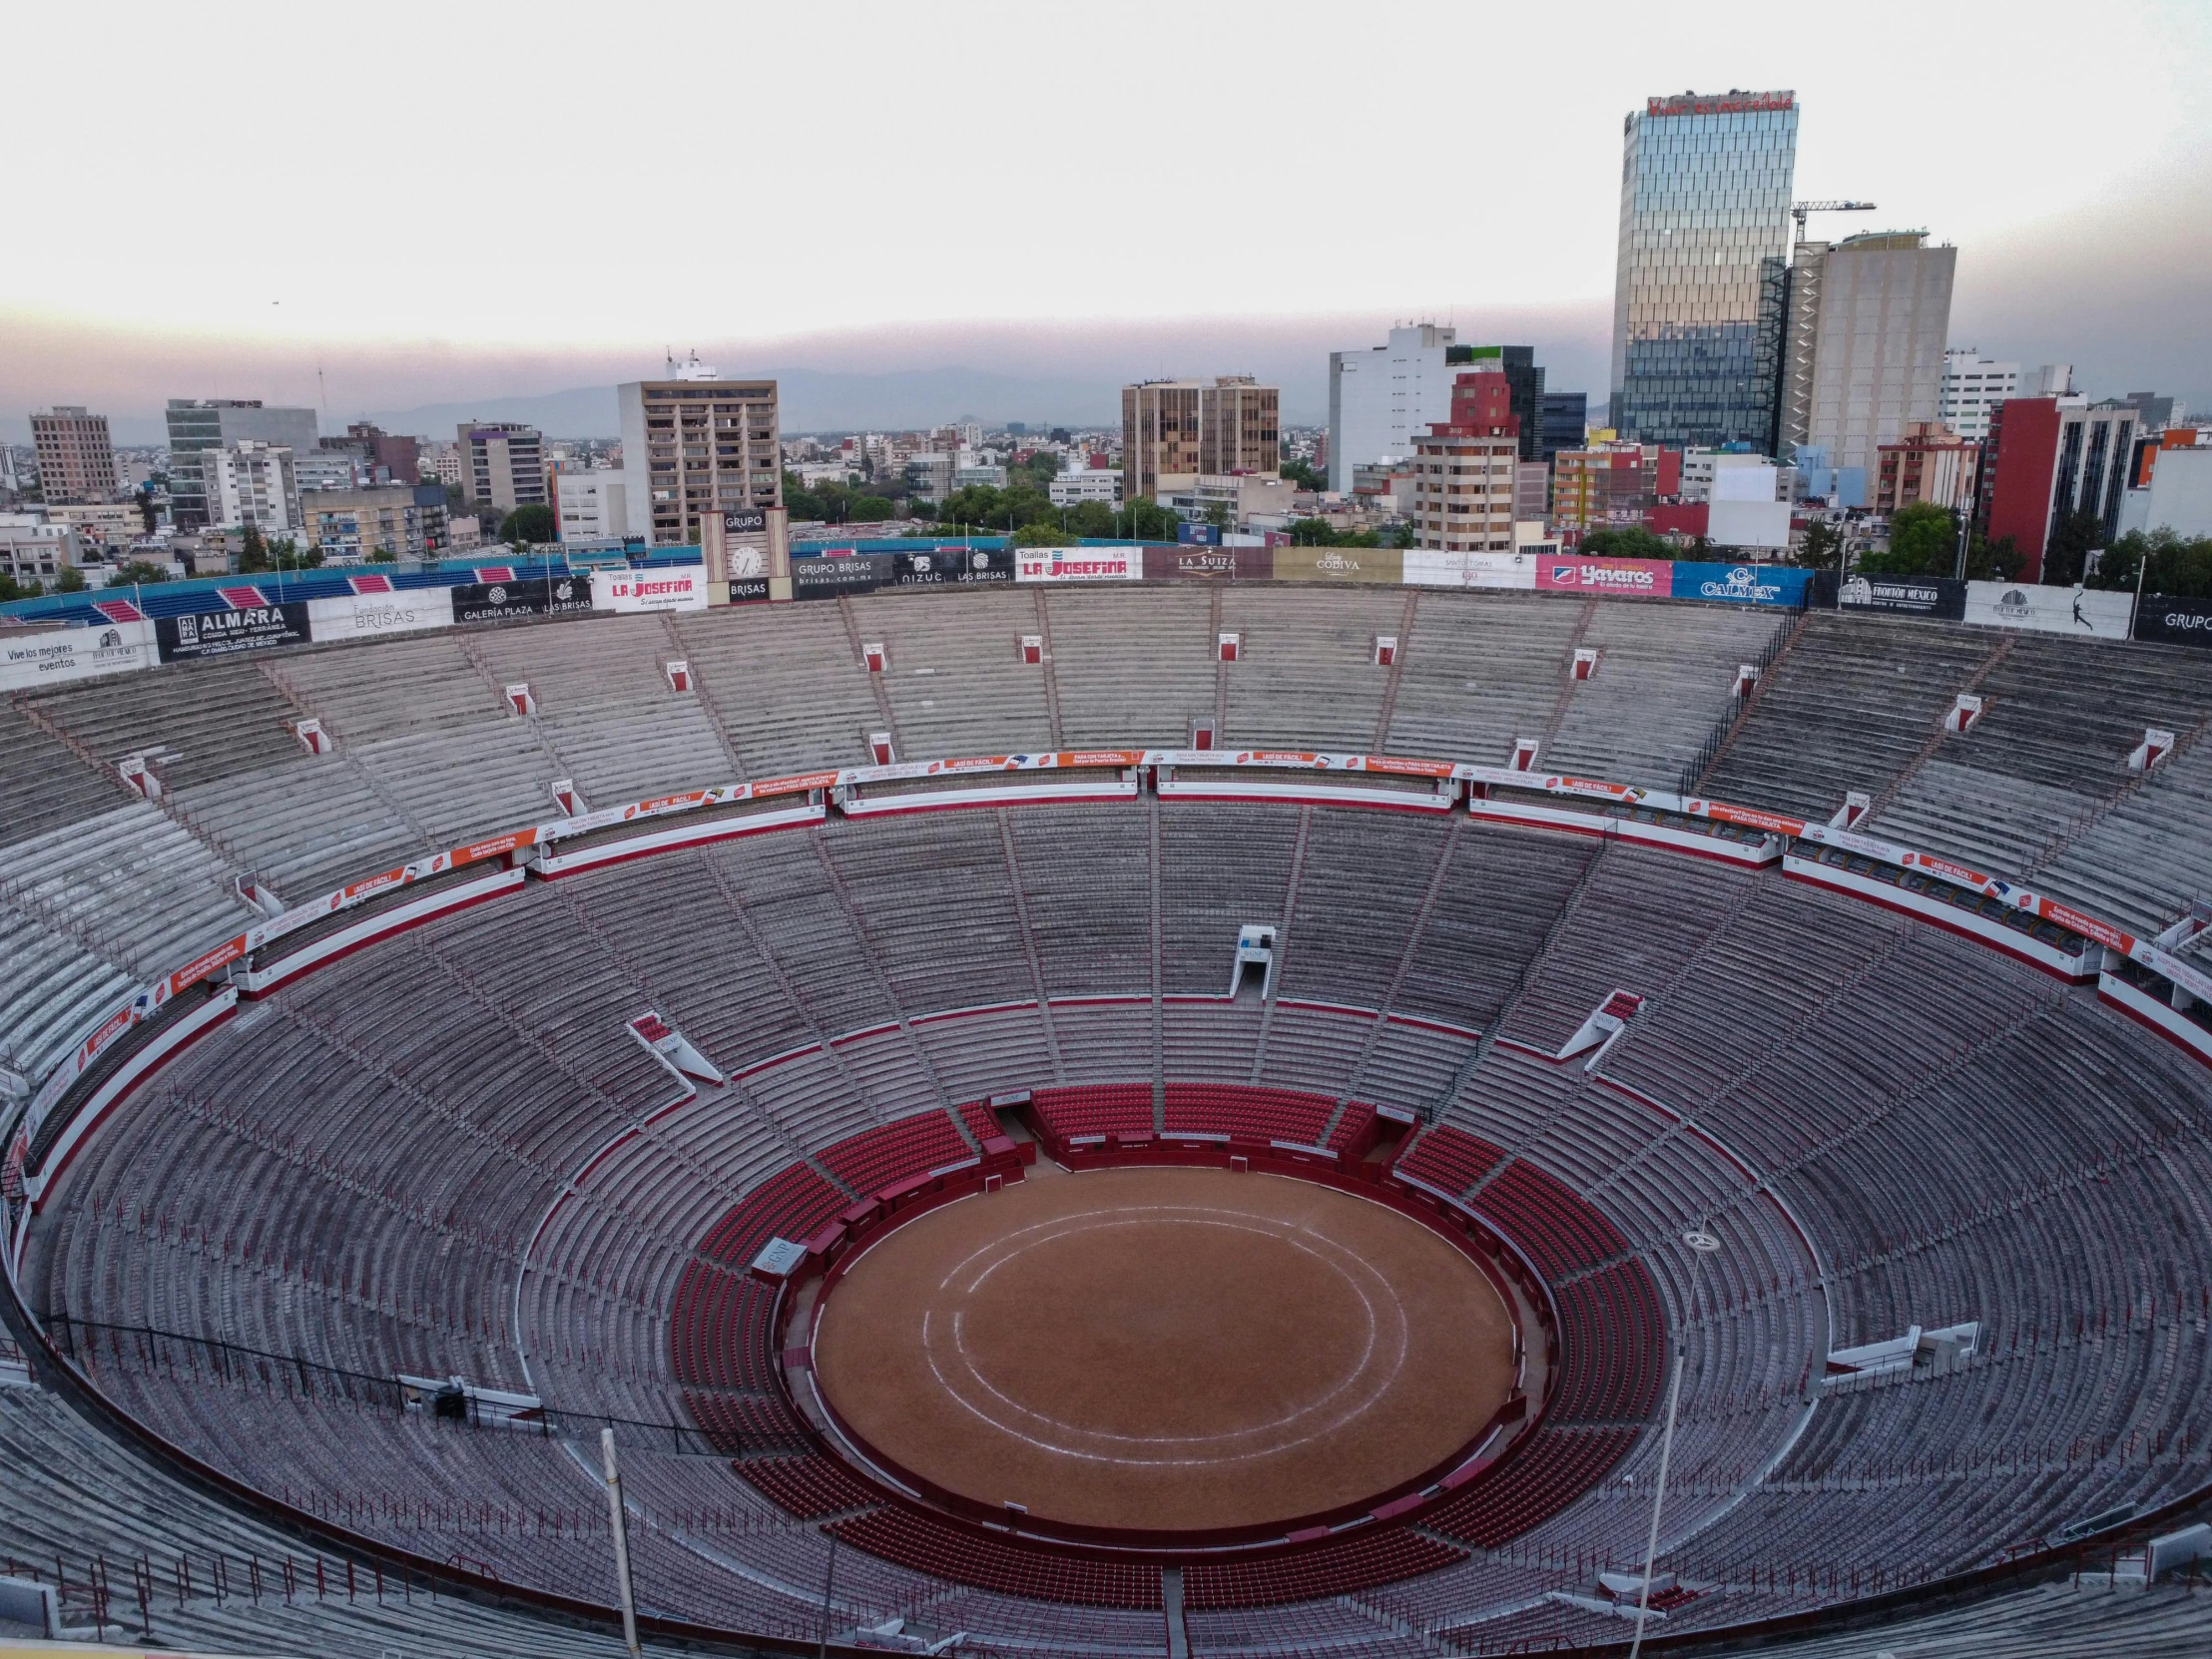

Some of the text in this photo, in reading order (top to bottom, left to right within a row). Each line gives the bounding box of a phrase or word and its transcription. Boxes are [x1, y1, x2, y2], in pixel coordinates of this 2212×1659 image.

[1649, 98, 1689, 117] Vivir
[1695, 103, 1710, 115] es
[726, 516, 763, 528] GRUPO
[799, 561, 871, 575] GRUPO BRISAS
[1179, 557, 1194, 566] LA
[1317, 559, 1360, 570] GODIVA
[958, 570, 1007, 581] LAS BRISAS
[1023, 563, 1042, 575] LA
[1580, 565, 1654, 585] Yavaros
[612, 584, 628, 597] LA
[731, 584, 766, 597] BRISAS
[1700, 582, 1781, 600] CALMEX
[1873, 585, 1937, 602] FRONTÓN MÉXICO
[353, 603, 395, 614] Fundación
[544, 599, 591, 612] LAS BRISAS
[355, 610, 415, 629] BRISAS
[464, 606, 533, 620] GALERÍA PLAZA
[7, 643, 73, 661] Vive los mejores
[38, 658, 76, 672] eventos
[1593, 783, 1612, 792] FÁCIL!
[1944, 864, 1952, 873] DE
[1953, 866, 1972, 881] FÁCIL!
[374, 874, 391, 886] FÁCIL!
[103, 1030, 109, 1040] DE
[768, 1243, 791, 1264] GNP
